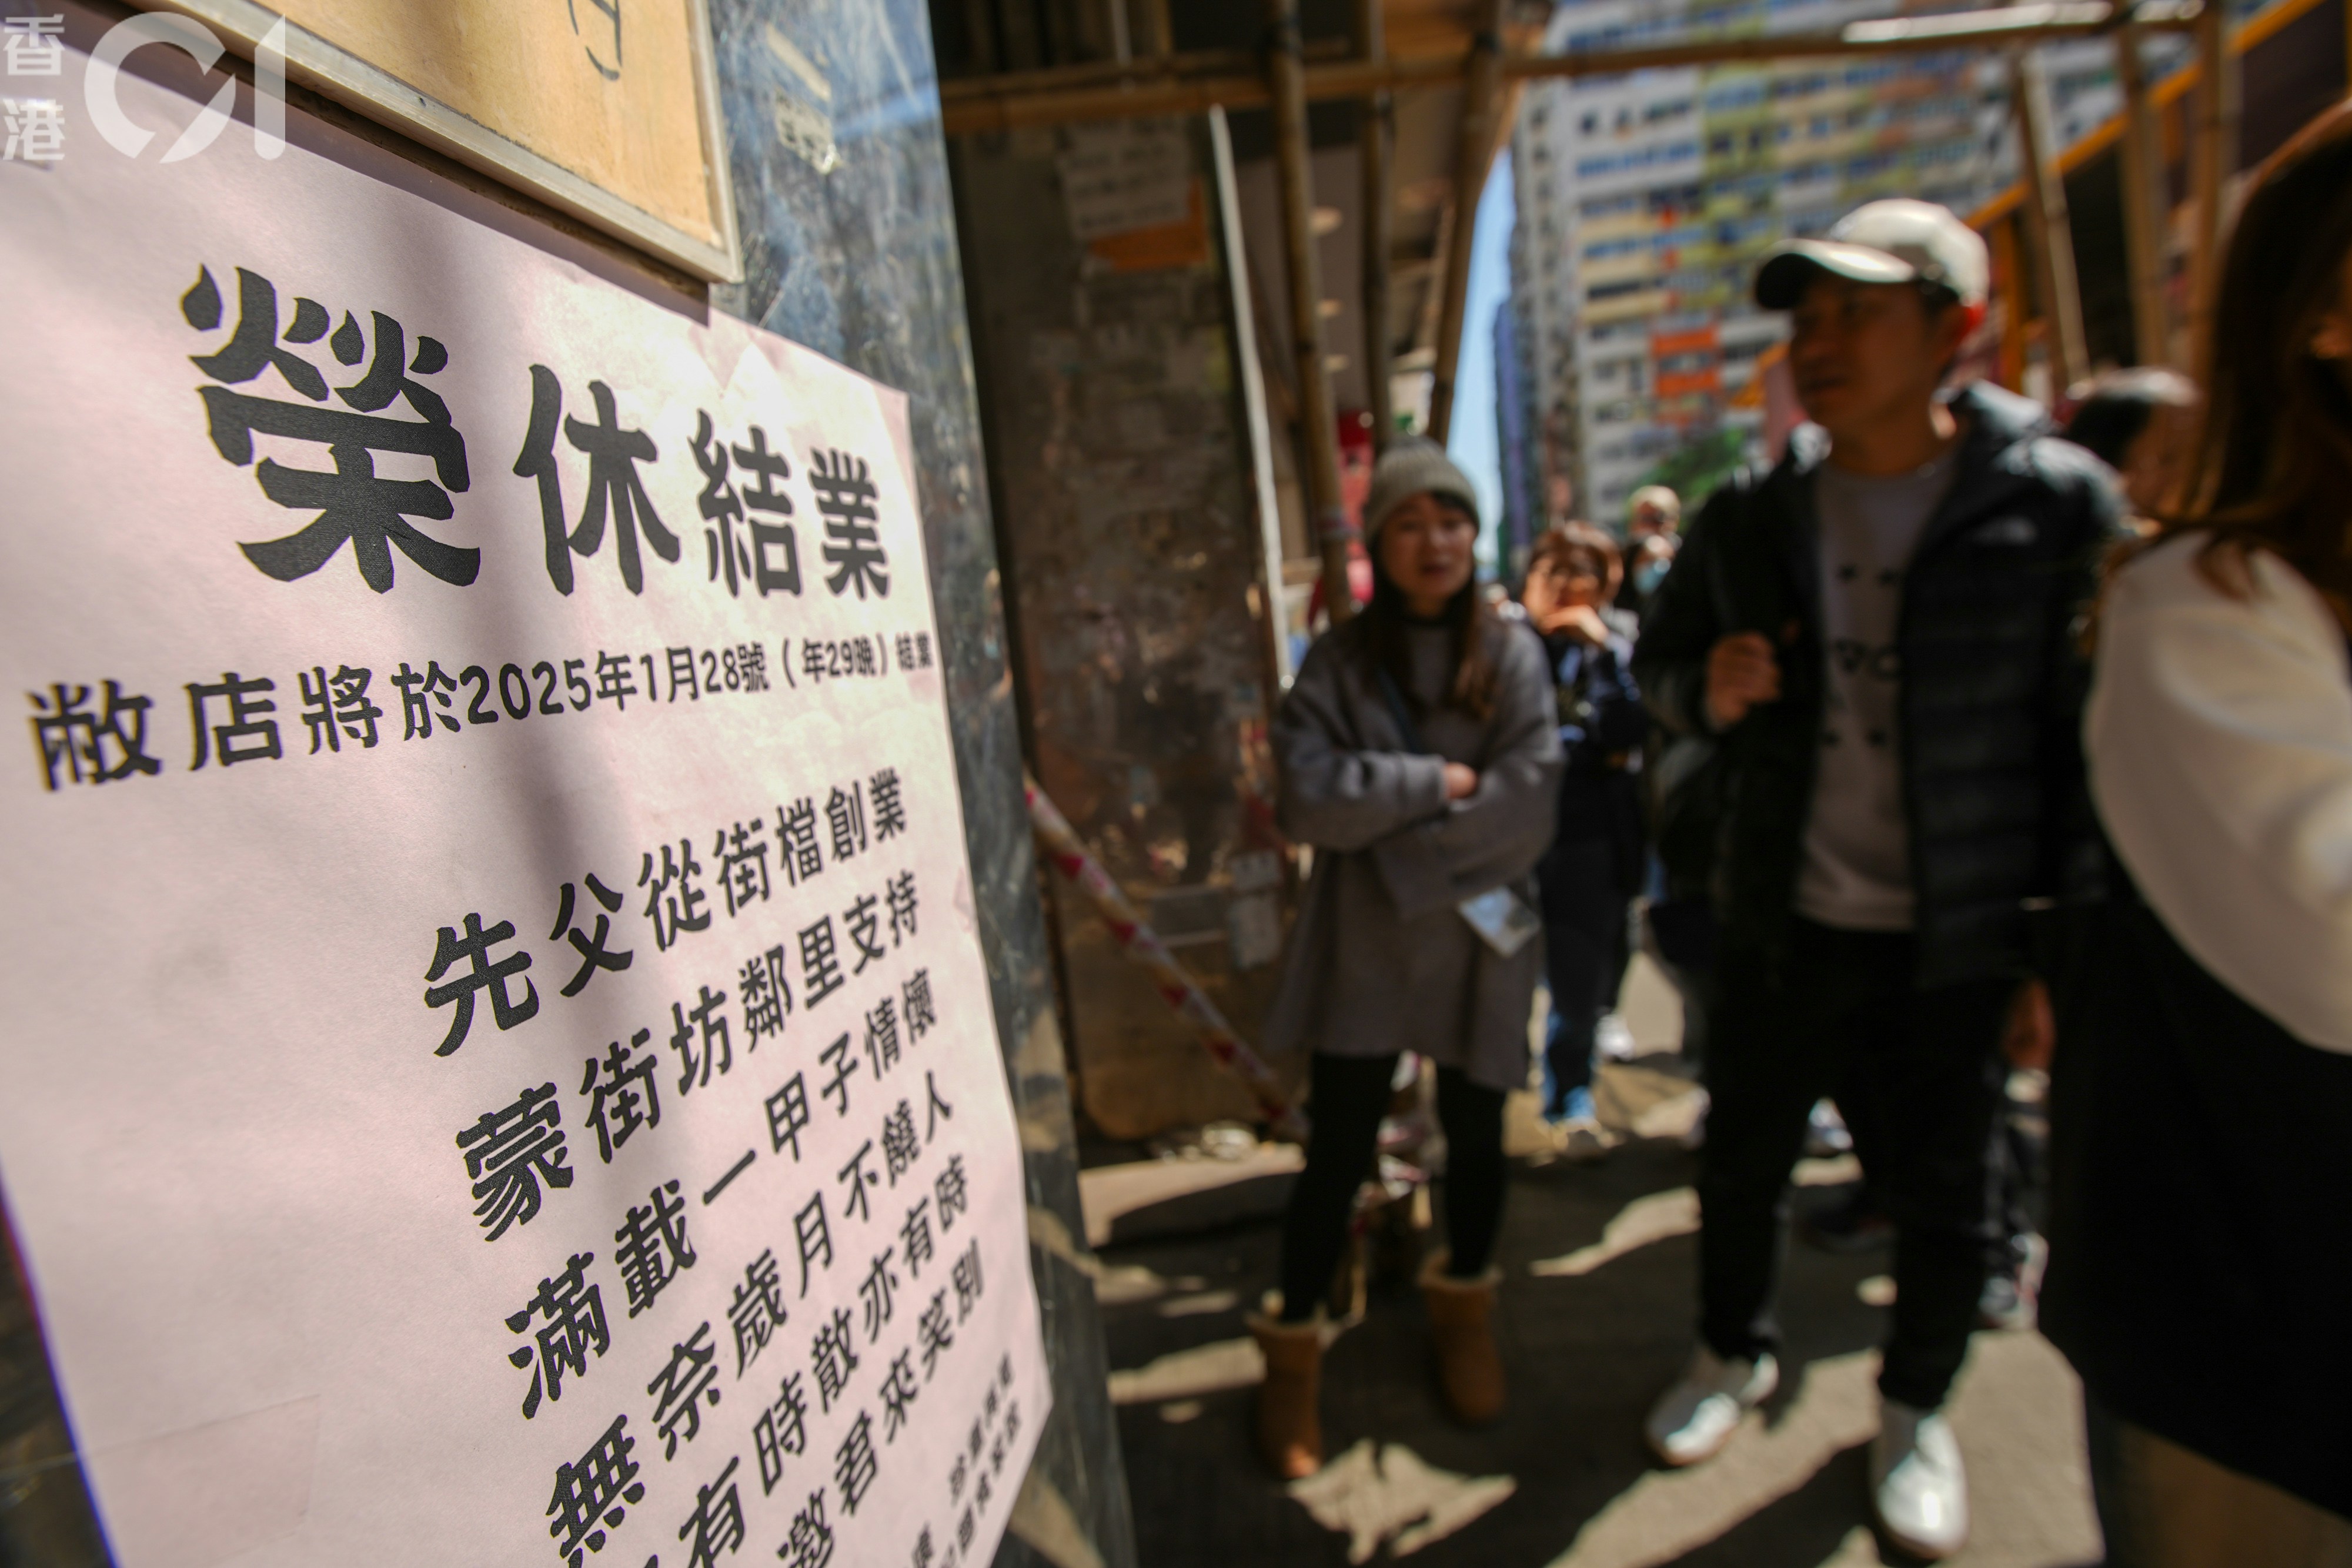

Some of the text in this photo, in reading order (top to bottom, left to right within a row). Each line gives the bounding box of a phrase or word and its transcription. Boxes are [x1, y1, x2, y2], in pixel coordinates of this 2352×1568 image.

[180, 263, 890, 599] 榮休結業
[424, 767, 907, 1057] 先父從街檔創業
[456, 869, 918, 1242] 蒙街坊鄰里支持
[505, 967, 936, 1420] 滿載一甲子情懷
[546, 1070, 953, 1568] 無奈歲月不饒人
[644, 1154, 967, 1568] 有時散亦有時
